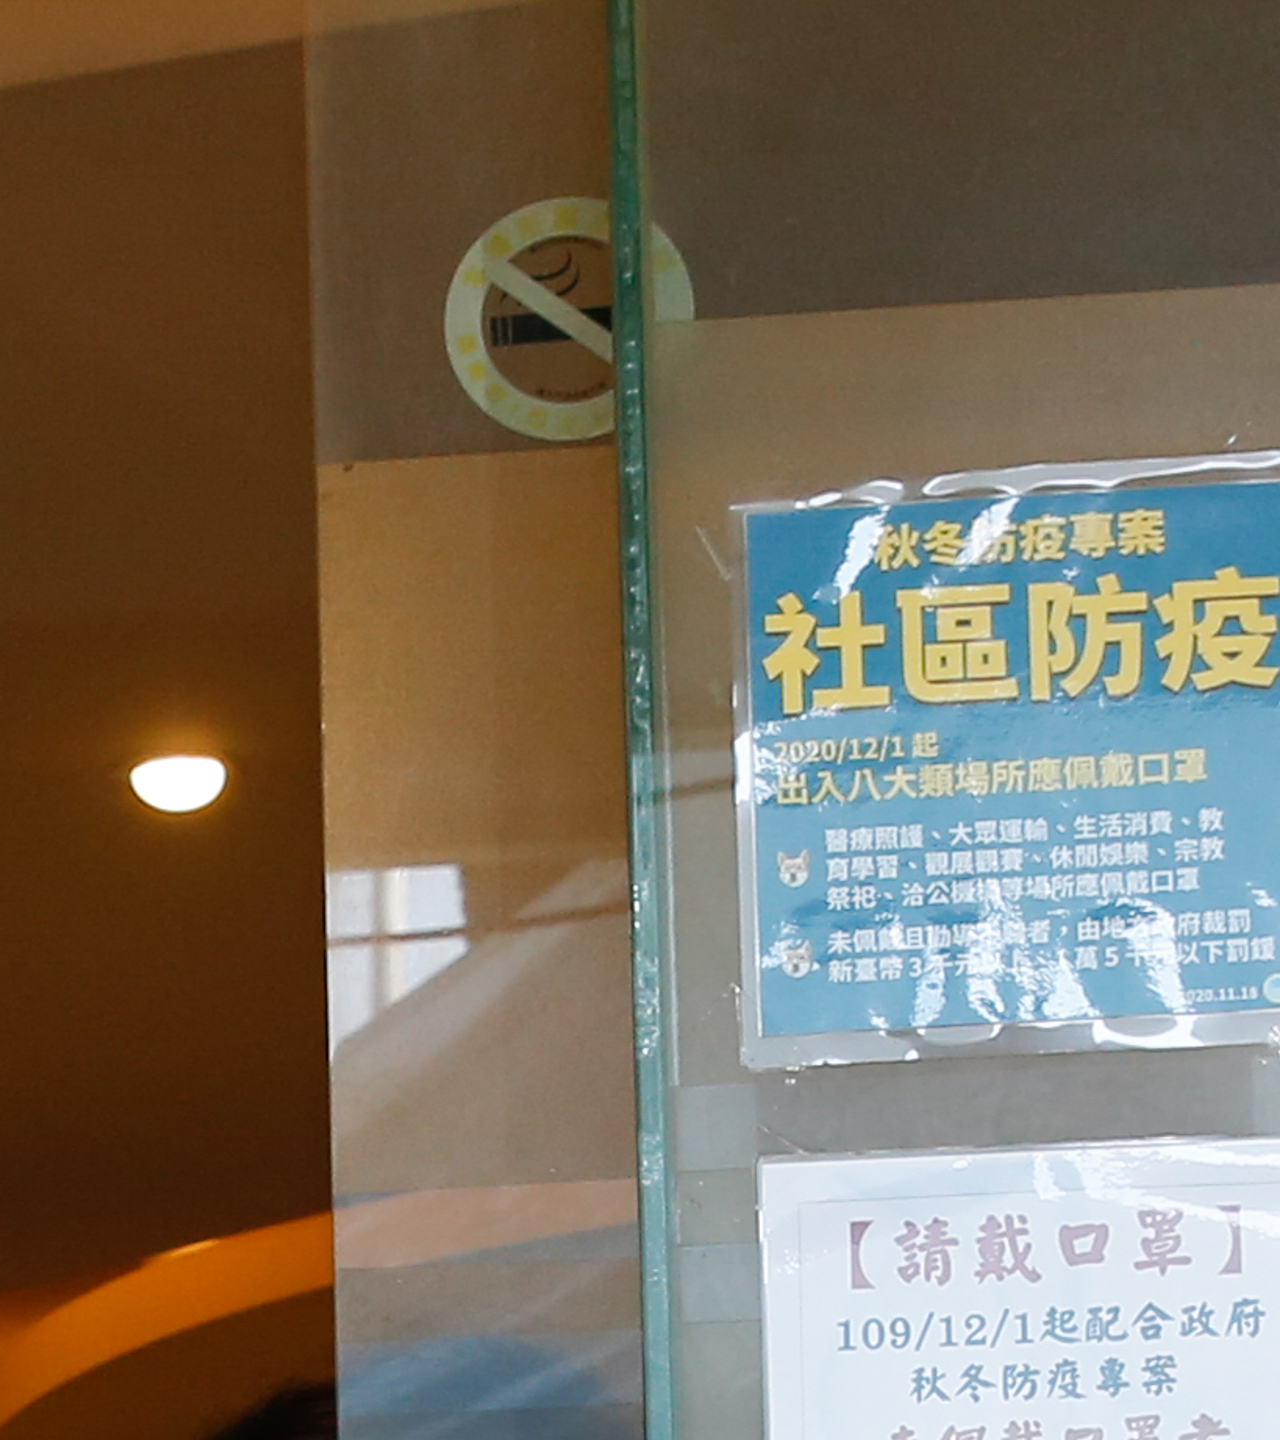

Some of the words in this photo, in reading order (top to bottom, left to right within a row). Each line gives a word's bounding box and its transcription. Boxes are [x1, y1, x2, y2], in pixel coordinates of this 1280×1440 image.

[762, 566, 1279, 716] 社區防疫
[776, 748, 1208, 806] 出入八大類場所應佩戴口罩
[837, 1298, 1267, 1352] 109/12/1起配合政府
[909, 1354, 1178, 1404] 秋冬防疫專案
